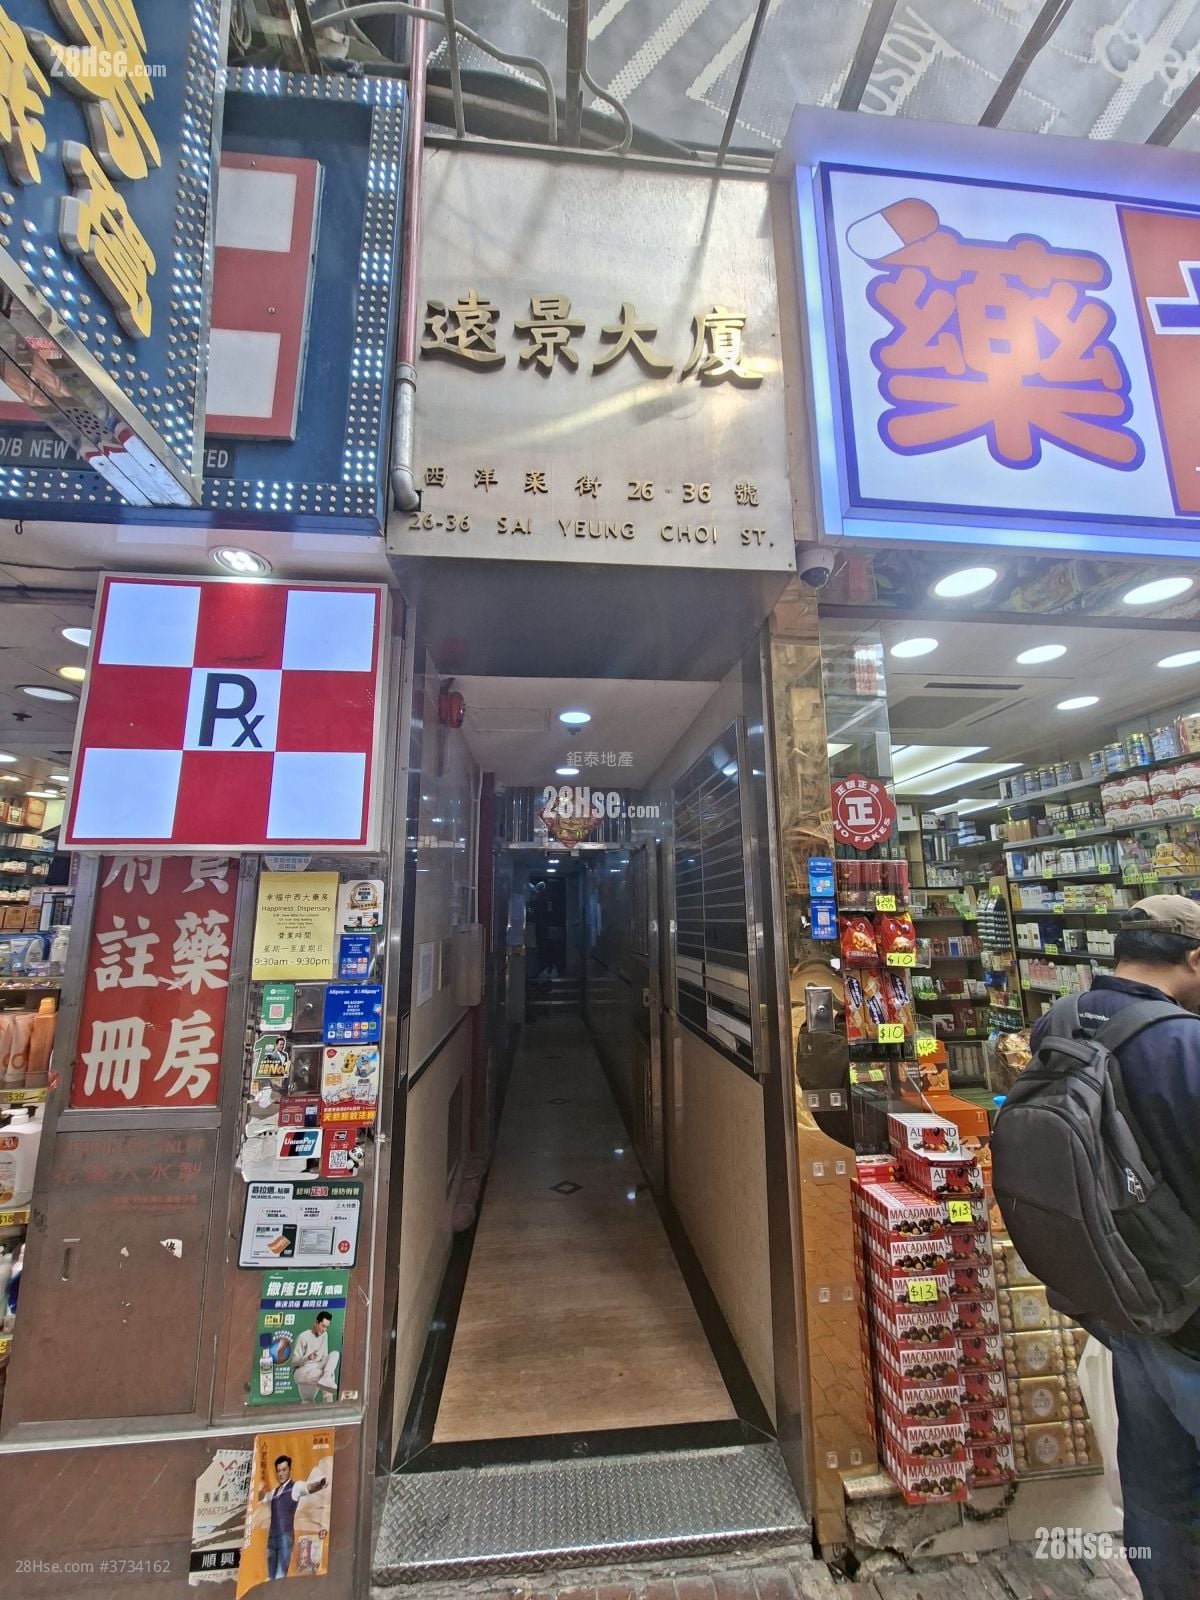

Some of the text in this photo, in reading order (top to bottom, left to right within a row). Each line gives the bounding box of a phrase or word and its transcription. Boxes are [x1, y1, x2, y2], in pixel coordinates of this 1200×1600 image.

[420, 288, 764, 388] 遠景大廈
[30, 441, 69, 460] NEW
[409, 512, 775, 548] 26-36 SAI YEUNG CHOI ST.
[845, 797, 876, 826] 正
[832, 817, 891, 843] NO FAKES
[261, 904, 331, 913] Happiness Dispensary
[254, 957, 288, 966] 9:30am
[296, 957, 331, 967] 9:30pm
[880, 1026, 903, 1039] $10
[889, 1207, 941, 1220] MACADAMIA
[951, 1205, 969, 1218] $13
[892, 1241, 945, 1255] MACADAMIA
[267, 1282, 323, 1296] 撒隆巴斯
[910, 1284, 934, 1300] $13
[897, 1313, 952, 1326] MACADAMIA
[901, 1350, 957, 1364] MACADAMIA
[904, 1387, 959, 1402] MACADAMIA
[908, 1425, 964, 1440] MACADAMIA
[908, 1463, 965, 1478] MACADAMIA
